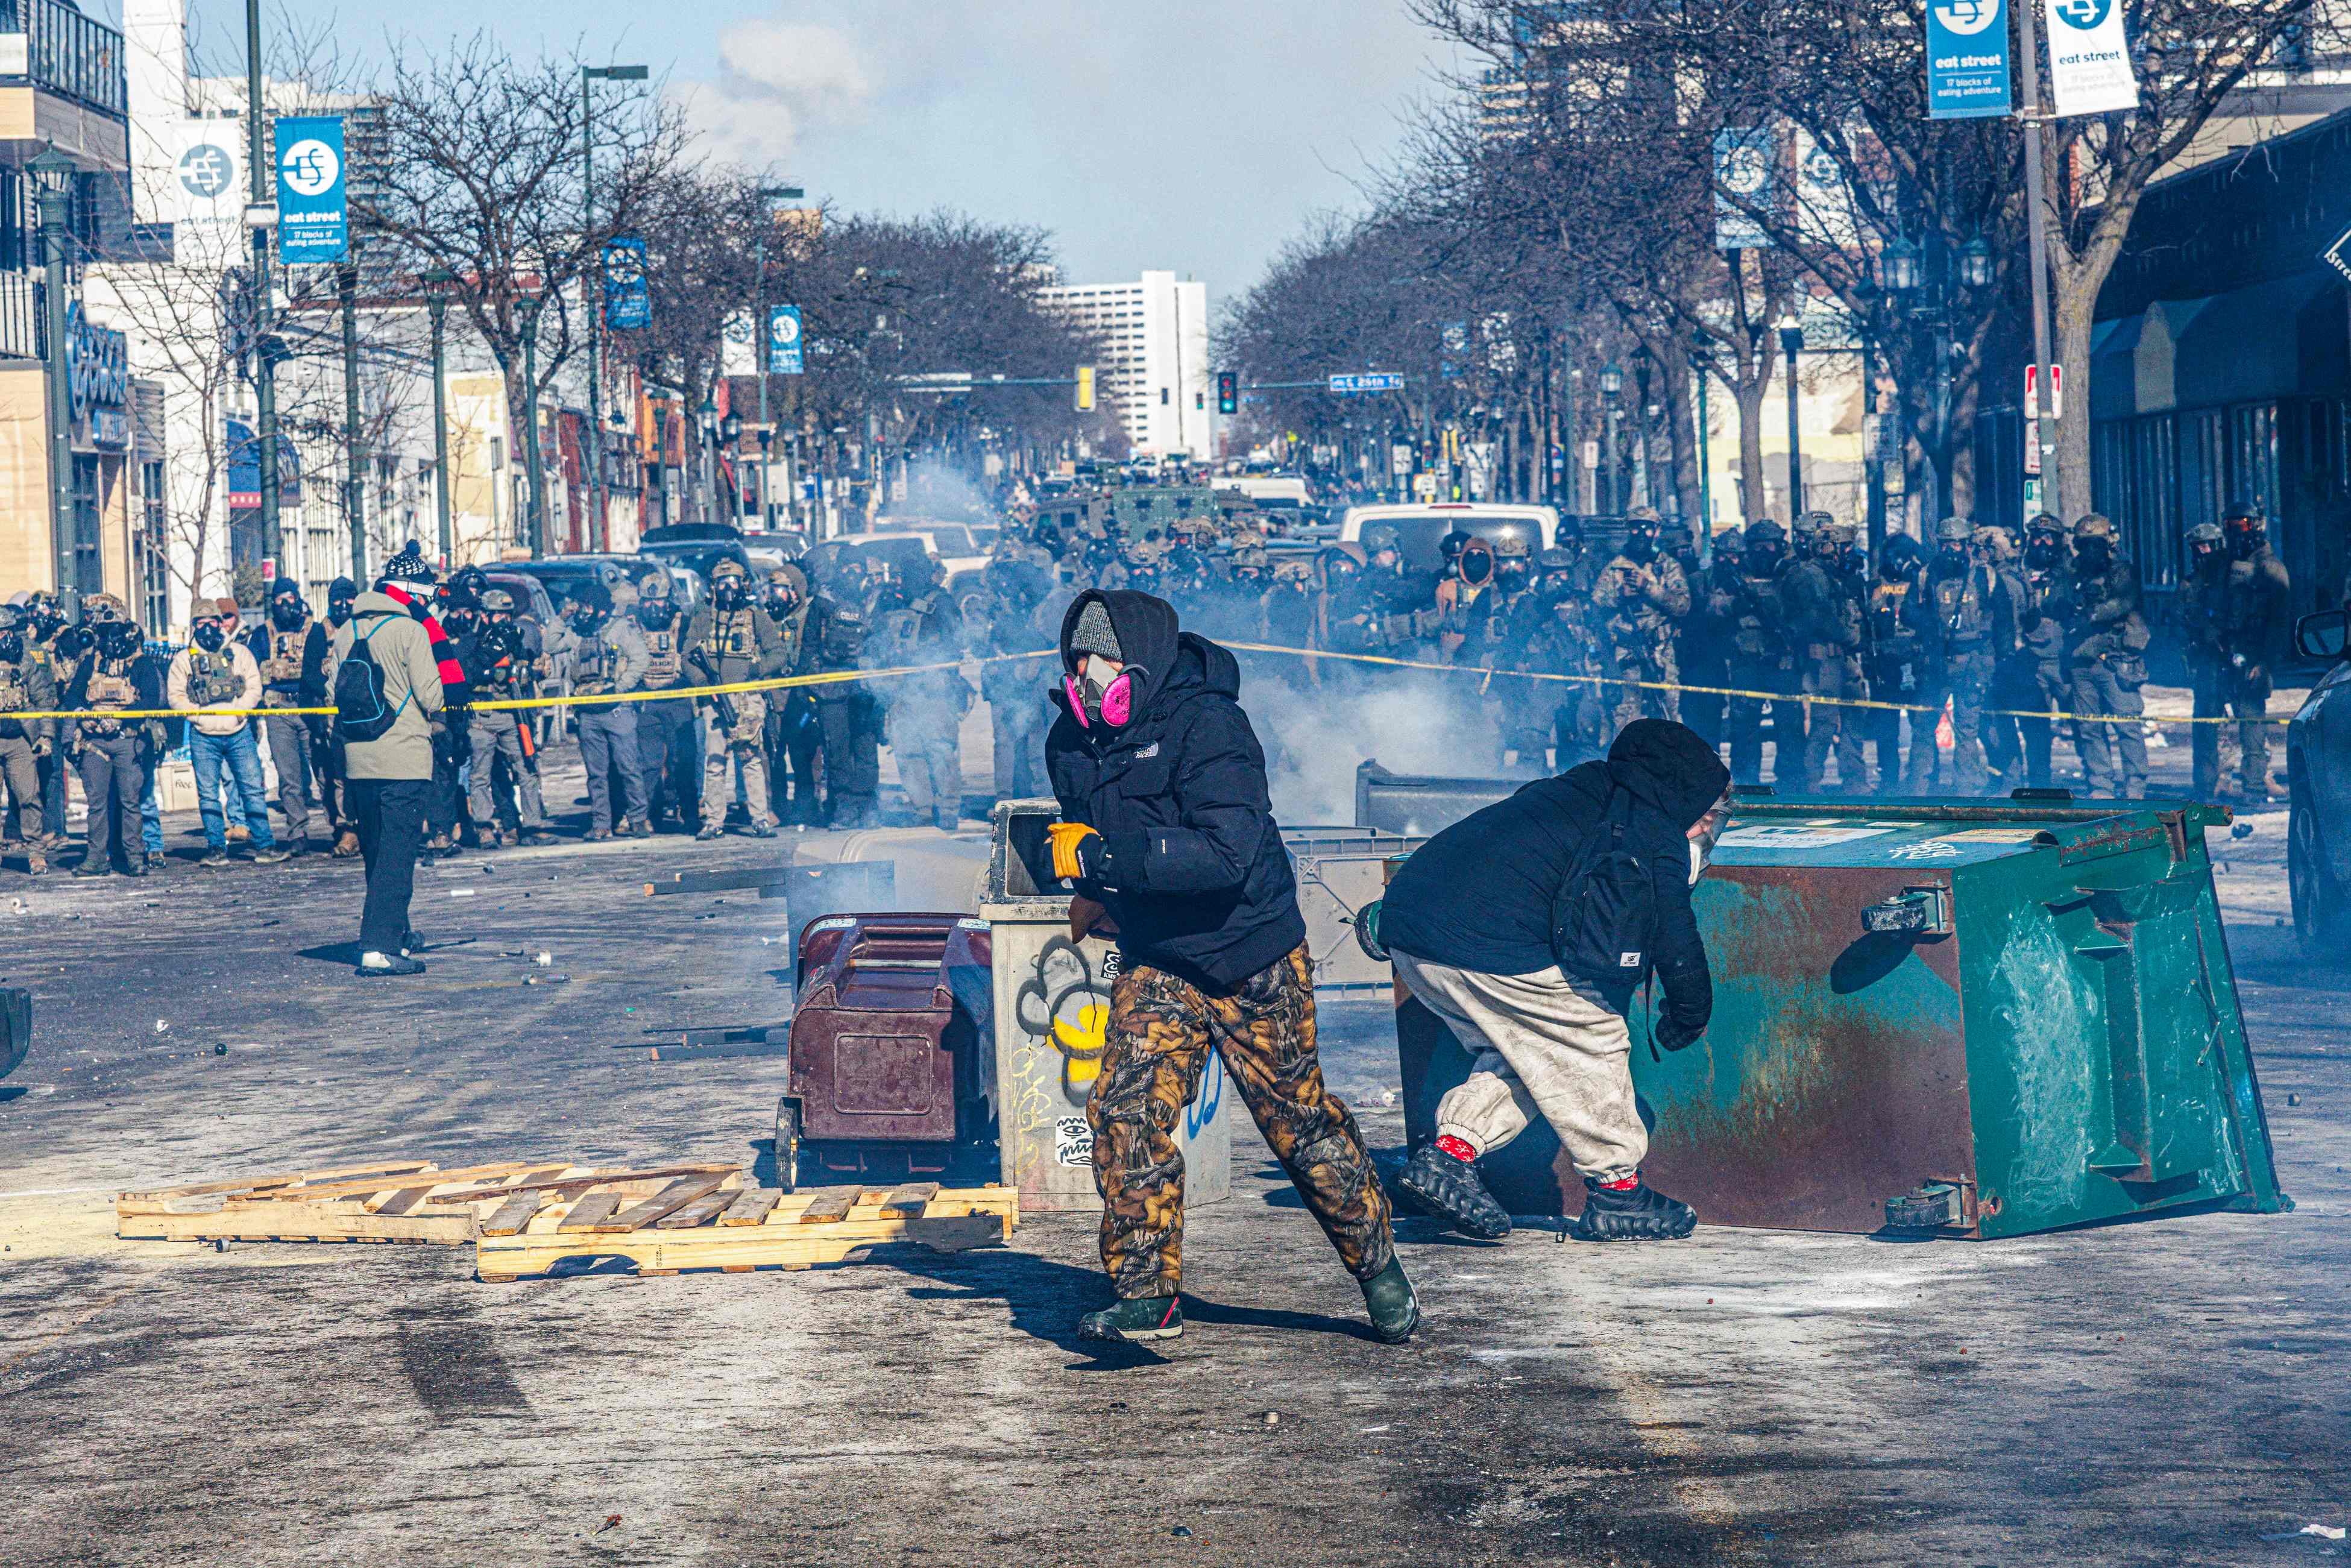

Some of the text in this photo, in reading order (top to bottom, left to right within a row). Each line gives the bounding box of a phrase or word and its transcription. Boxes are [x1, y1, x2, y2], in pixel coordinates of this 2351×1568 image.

[1935, 54, 2001, 68] eat street
[2059, 51, 2120, 65] eat street
[1947, 77, 1992, 87] 17 blocks of
[1937, 87, 2001, 98] eating adventure
[285, 210, 341, 222] eat street
[1881, 584, 1907, 595] POLICE
